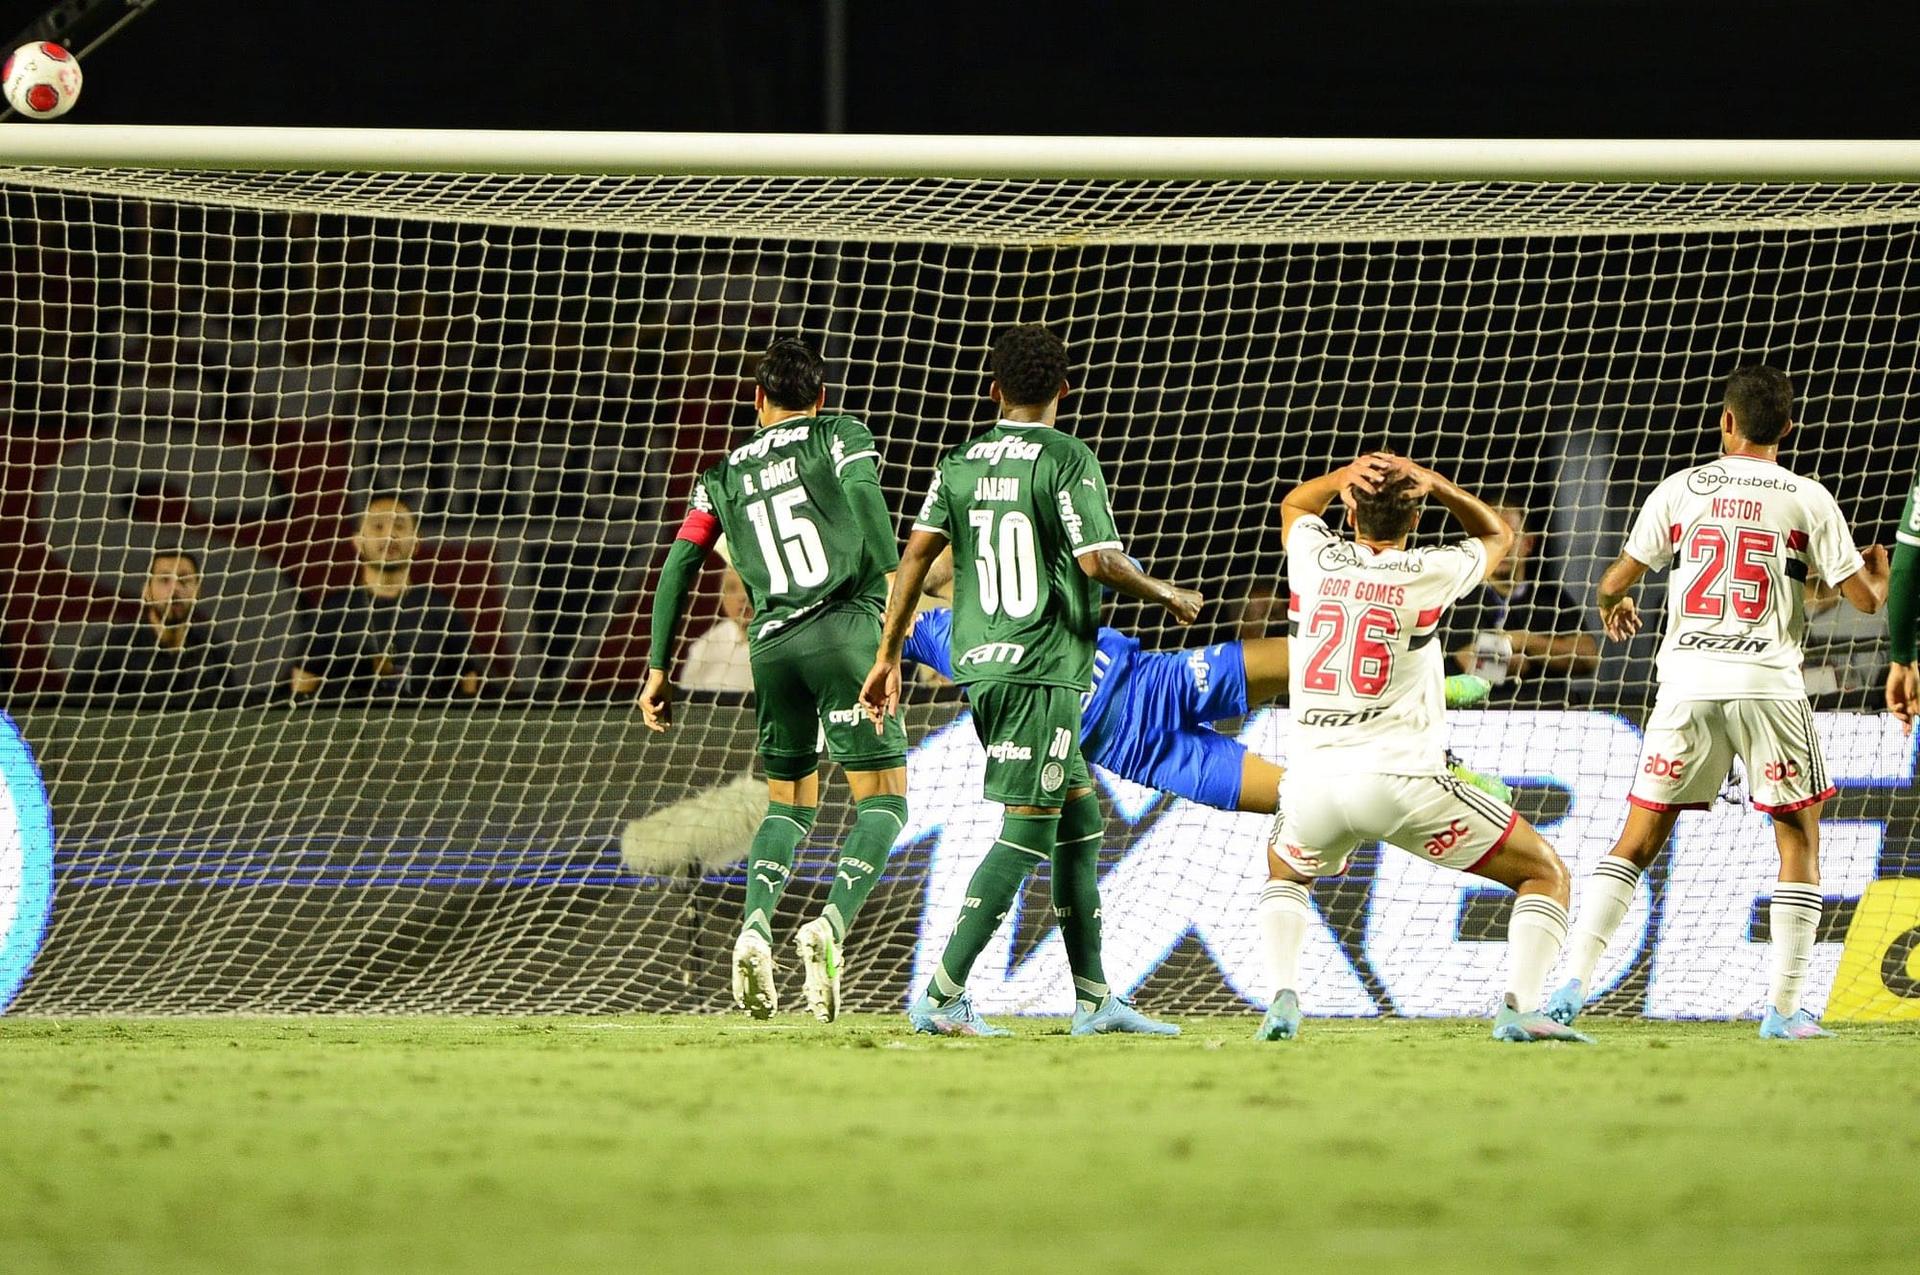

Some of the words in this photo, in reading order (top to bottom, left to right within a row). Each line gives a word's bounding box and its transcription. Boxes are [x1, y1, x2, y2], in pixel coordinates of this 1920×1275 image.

[729, 426, 810, 465] crefisa
[966, 435, 1043, 466] crefisa
[1697, 471, 1798, 493] Sportsbet.io
[1712, 497, 1763, 522] NESTOR
[746, 485, 830, 595] 15
[968, 509, 1040, 619] 30
[1681, 523, 1780, 625] 25
[1318, 577, 1351, 598] IGOR
[1355, 581, 1406, 607] GOMES
[1302, 599, 1402, 700] 26
[986, 740, 1033, 764] refisa
[1048, 726, 1072, 761] 30
[1643, 752, 1687, 780] abc
[1764, 759, 1799, 782] abc
[1423, 817, 1469, 857] abc
